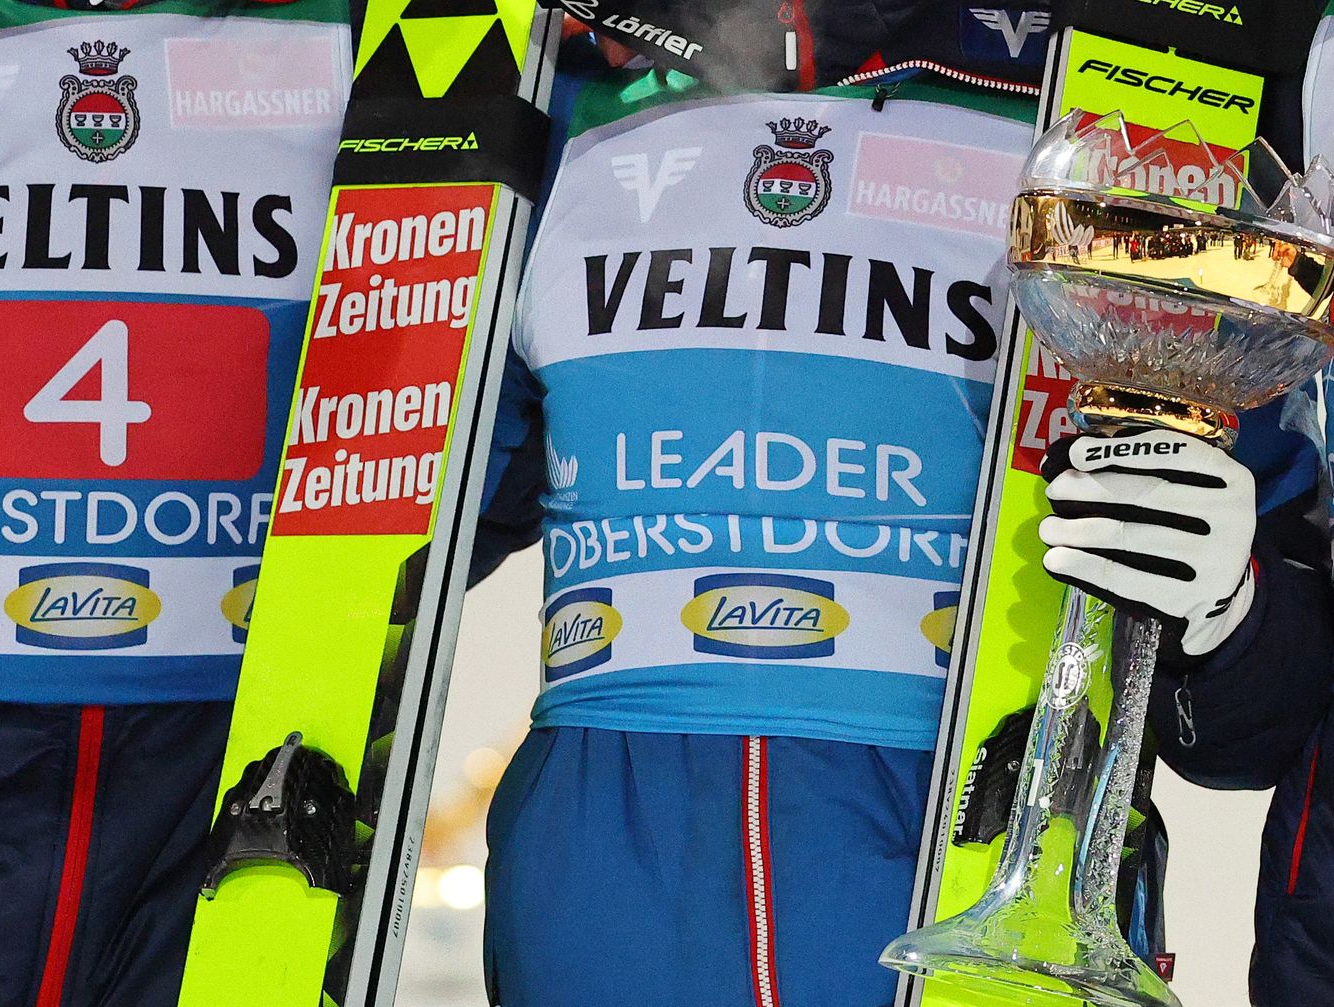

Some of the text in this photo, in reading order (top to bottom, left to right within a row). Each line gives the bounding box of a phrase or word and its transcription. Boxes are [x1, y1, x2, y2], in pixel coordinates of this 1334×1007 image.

[175, 88, 332, 117] HARGASSNER
[1077, 59, 1256, 115] FISCHER
[337, 135, 463, 154] FISCHER
[322, 206, 486, 272] Kronen
[313, 274, 479, 340] Zeitung
[583, 245, 1000, 362] VELTINS
[23, 318, 152, 468] 4
[287, 380, 453, 446] Kronen
[278, 448, 444, 514] Zeitung
[615, 429, 927, 507] LEADER
